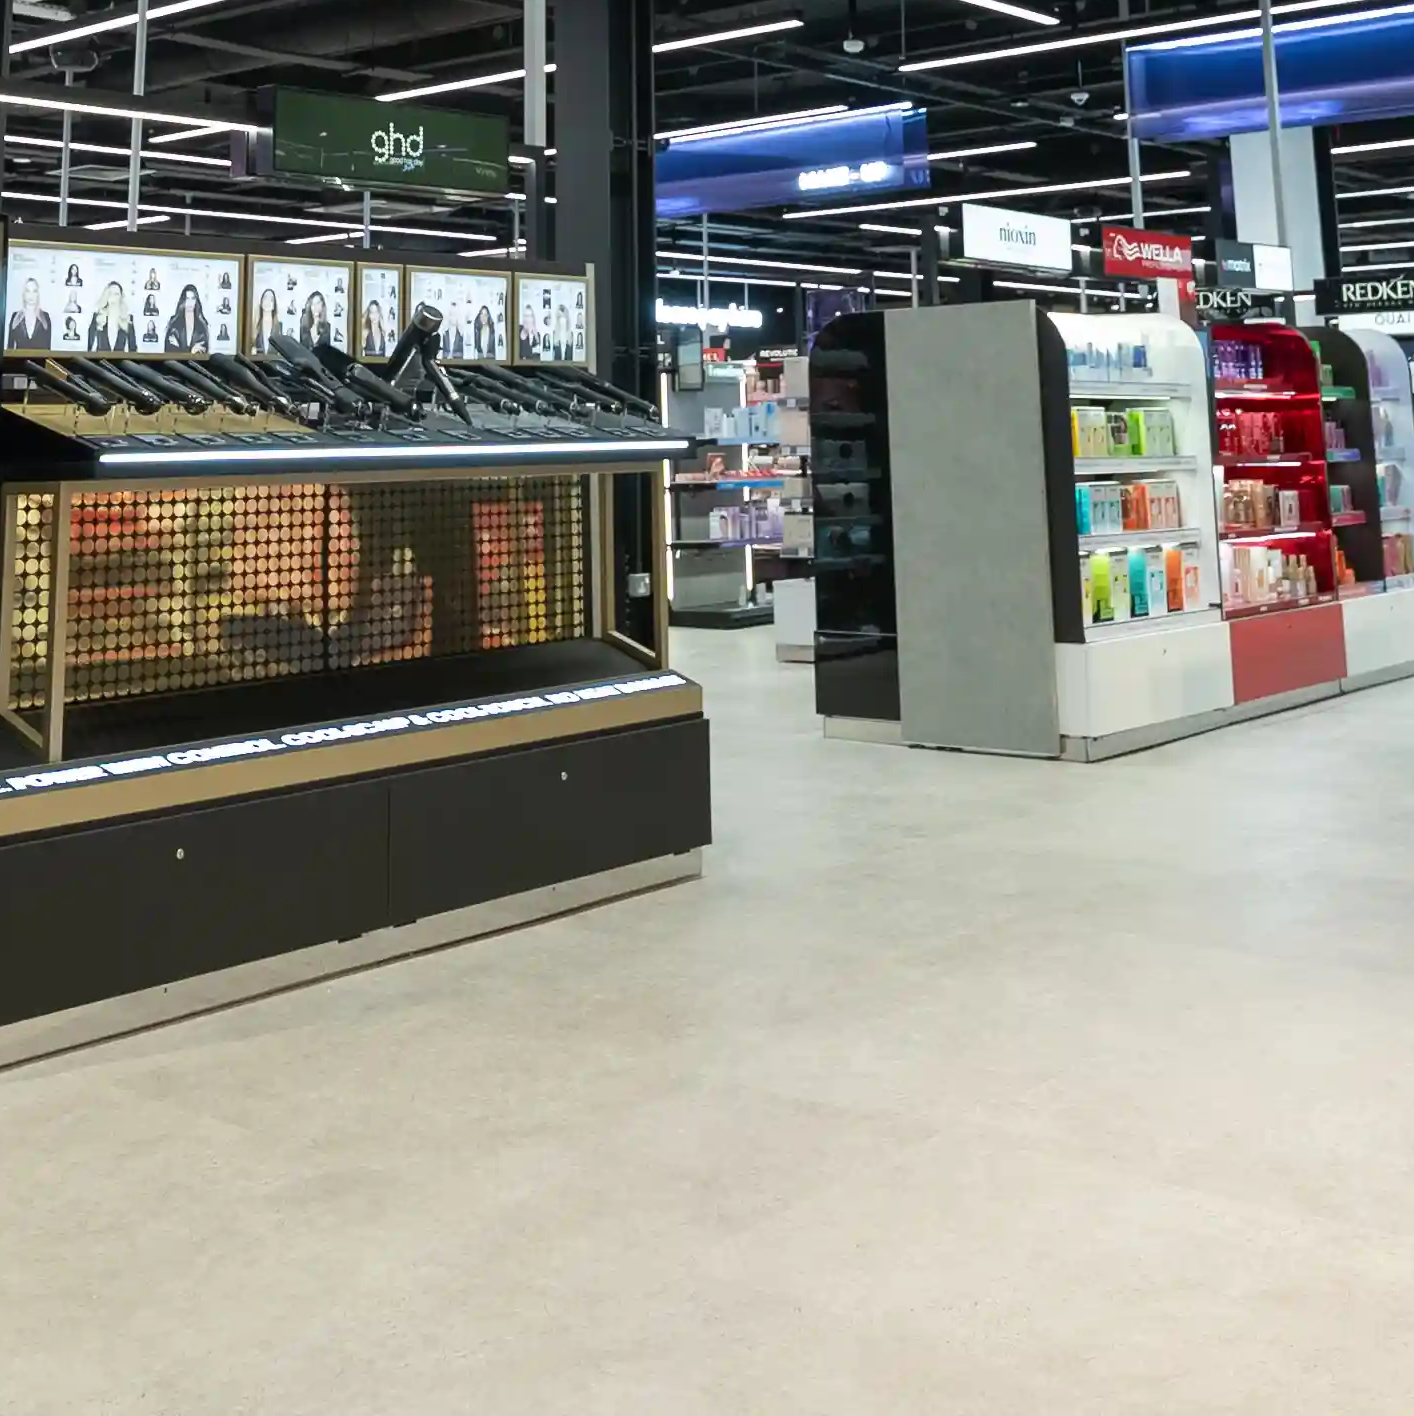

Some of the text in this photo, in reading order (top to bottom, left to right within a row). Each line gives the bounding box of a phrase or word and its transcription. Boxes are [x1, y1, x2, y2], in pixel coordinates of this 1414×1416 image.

[370, 122, 424, 163] ghd
[999, 221, 1036, 246] nioxin
[1140, 242, 1183, 263] WELLA
[1195, 290, 1252, 309] DKEN
